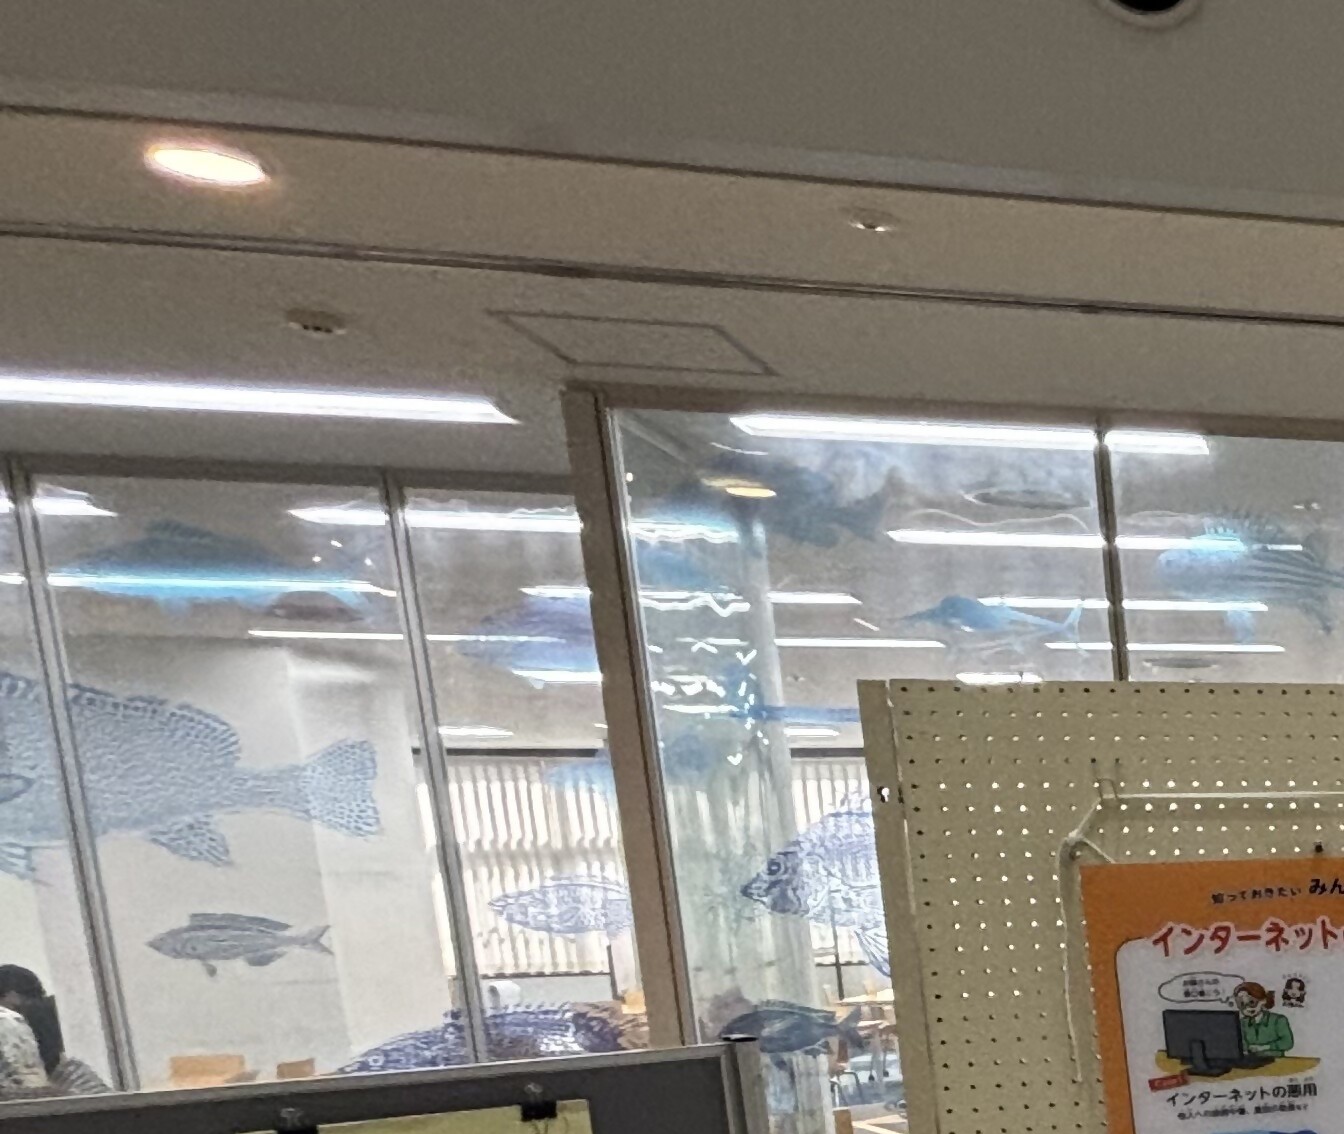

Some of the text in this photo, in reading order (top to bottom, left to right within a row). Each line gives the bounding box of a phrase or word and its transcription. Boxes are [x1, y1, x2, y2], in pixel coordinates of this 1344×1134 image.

[1167, 1082, 1317, 1107] インターネットの悪用
